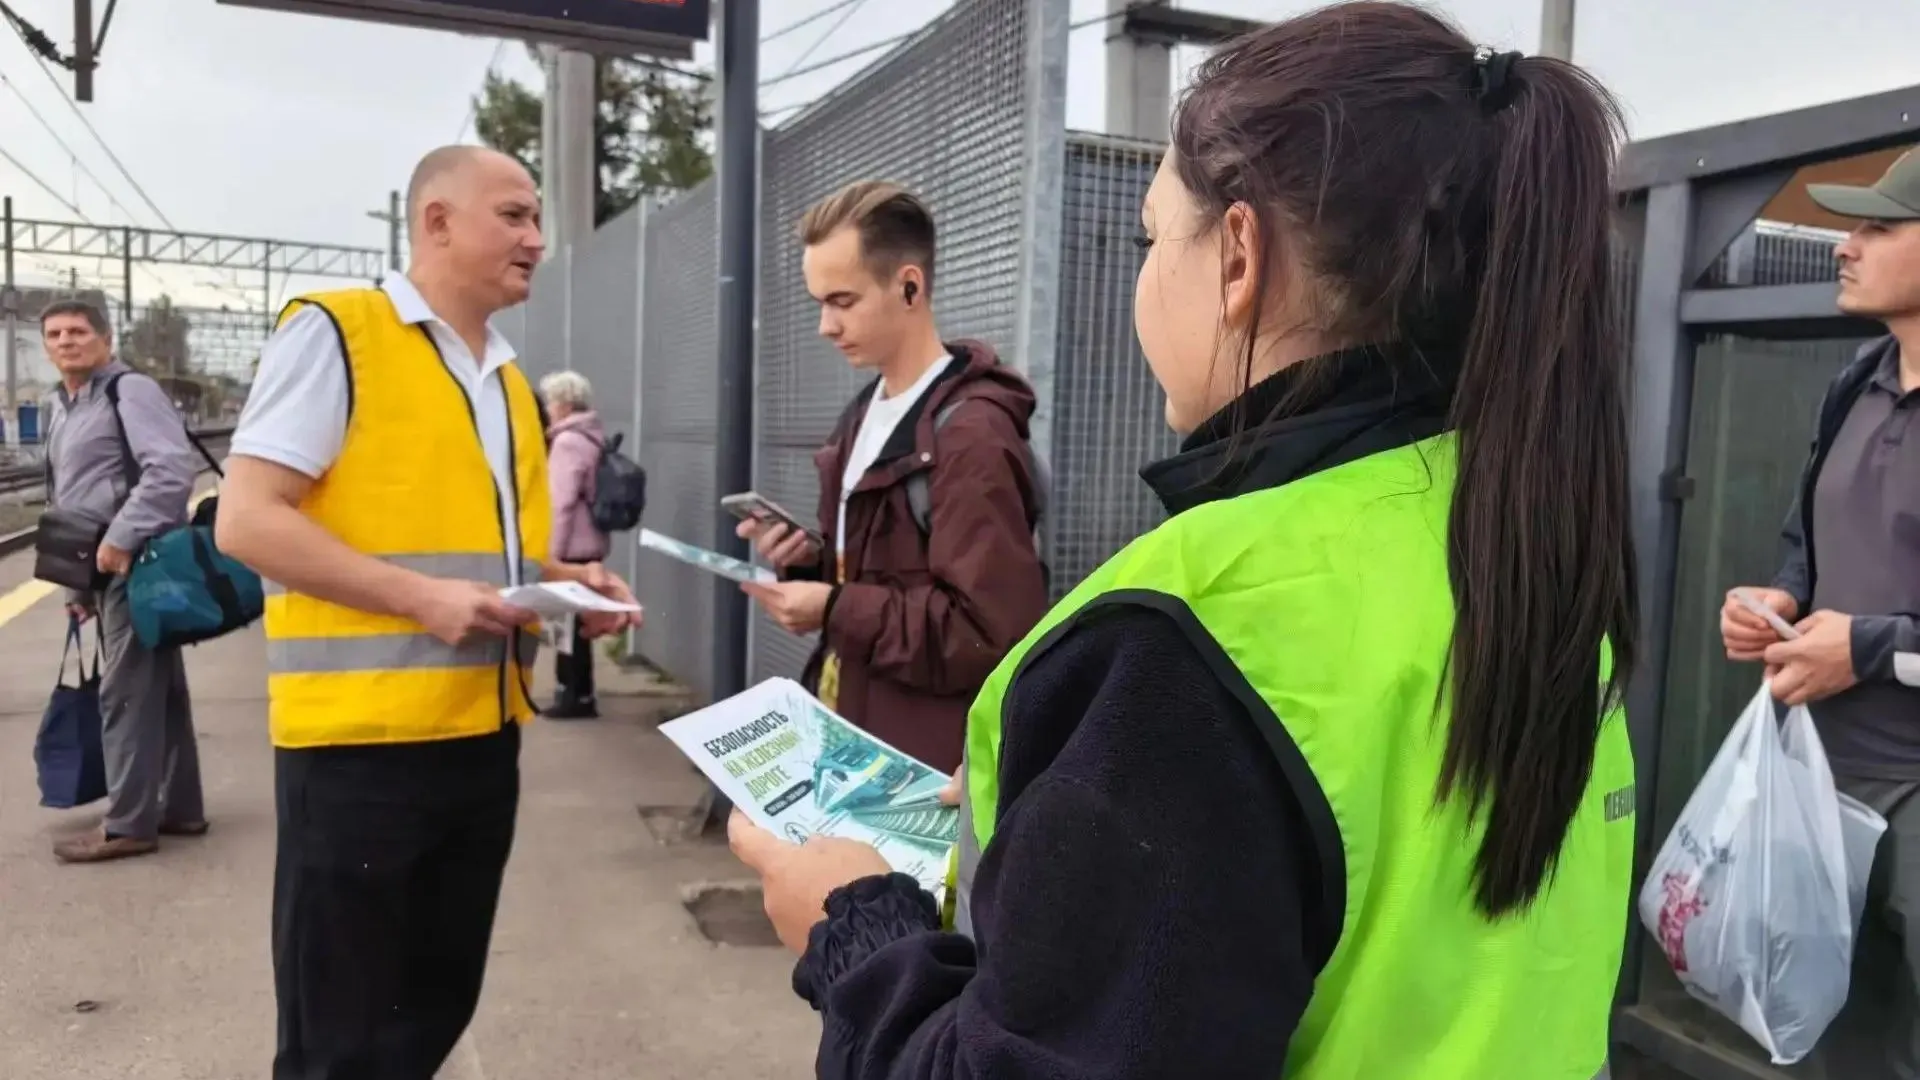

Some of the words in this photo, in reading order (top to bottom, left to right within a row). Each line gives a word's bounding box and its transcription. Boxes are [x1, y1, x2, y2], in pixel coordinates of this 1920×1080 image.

[703, 710, 789, 758] БЕЗОПАСНОСТЬ
[722, 759, 745, 779] НА
[738, 725, 801, 771] ЖЕЛЕЗНОЙ
[744, 764, 792, 802] ДОРОГЕ
